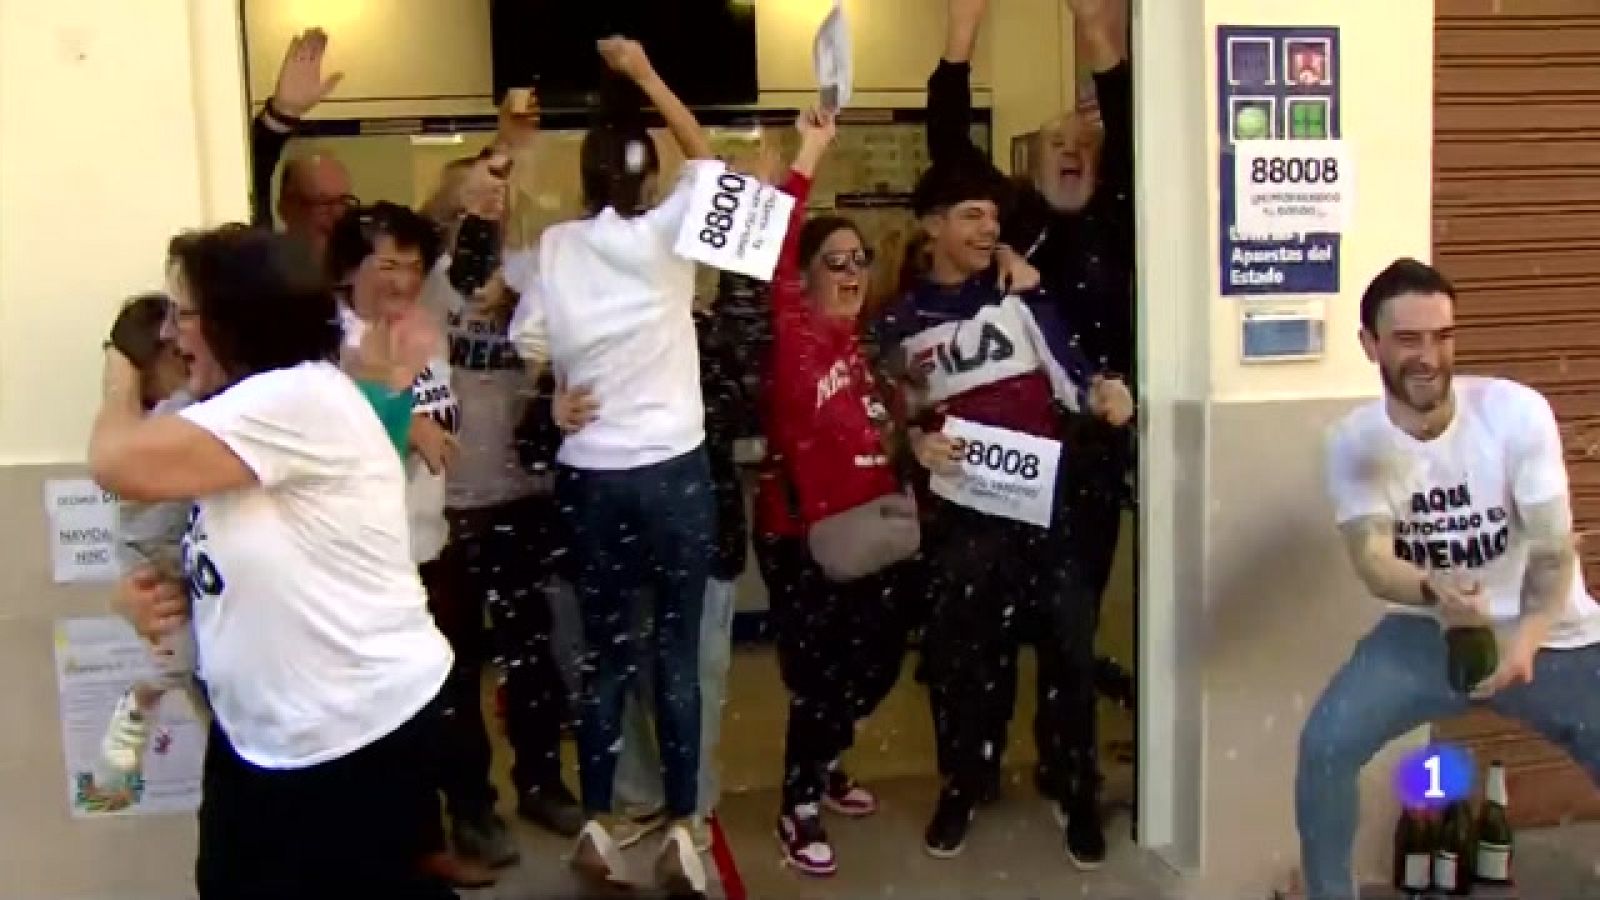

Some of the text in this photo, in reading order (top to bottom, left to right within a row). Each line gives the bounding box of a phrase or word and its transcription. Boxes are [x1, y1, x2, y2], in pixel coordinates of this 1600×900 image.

[1252, 156, 1338, 184] 88008
[699, 173, 746, 251] 8800
[1231, 244, 1332, 267] Apuestas del
[1230, 266, 1285, 285] Estado
